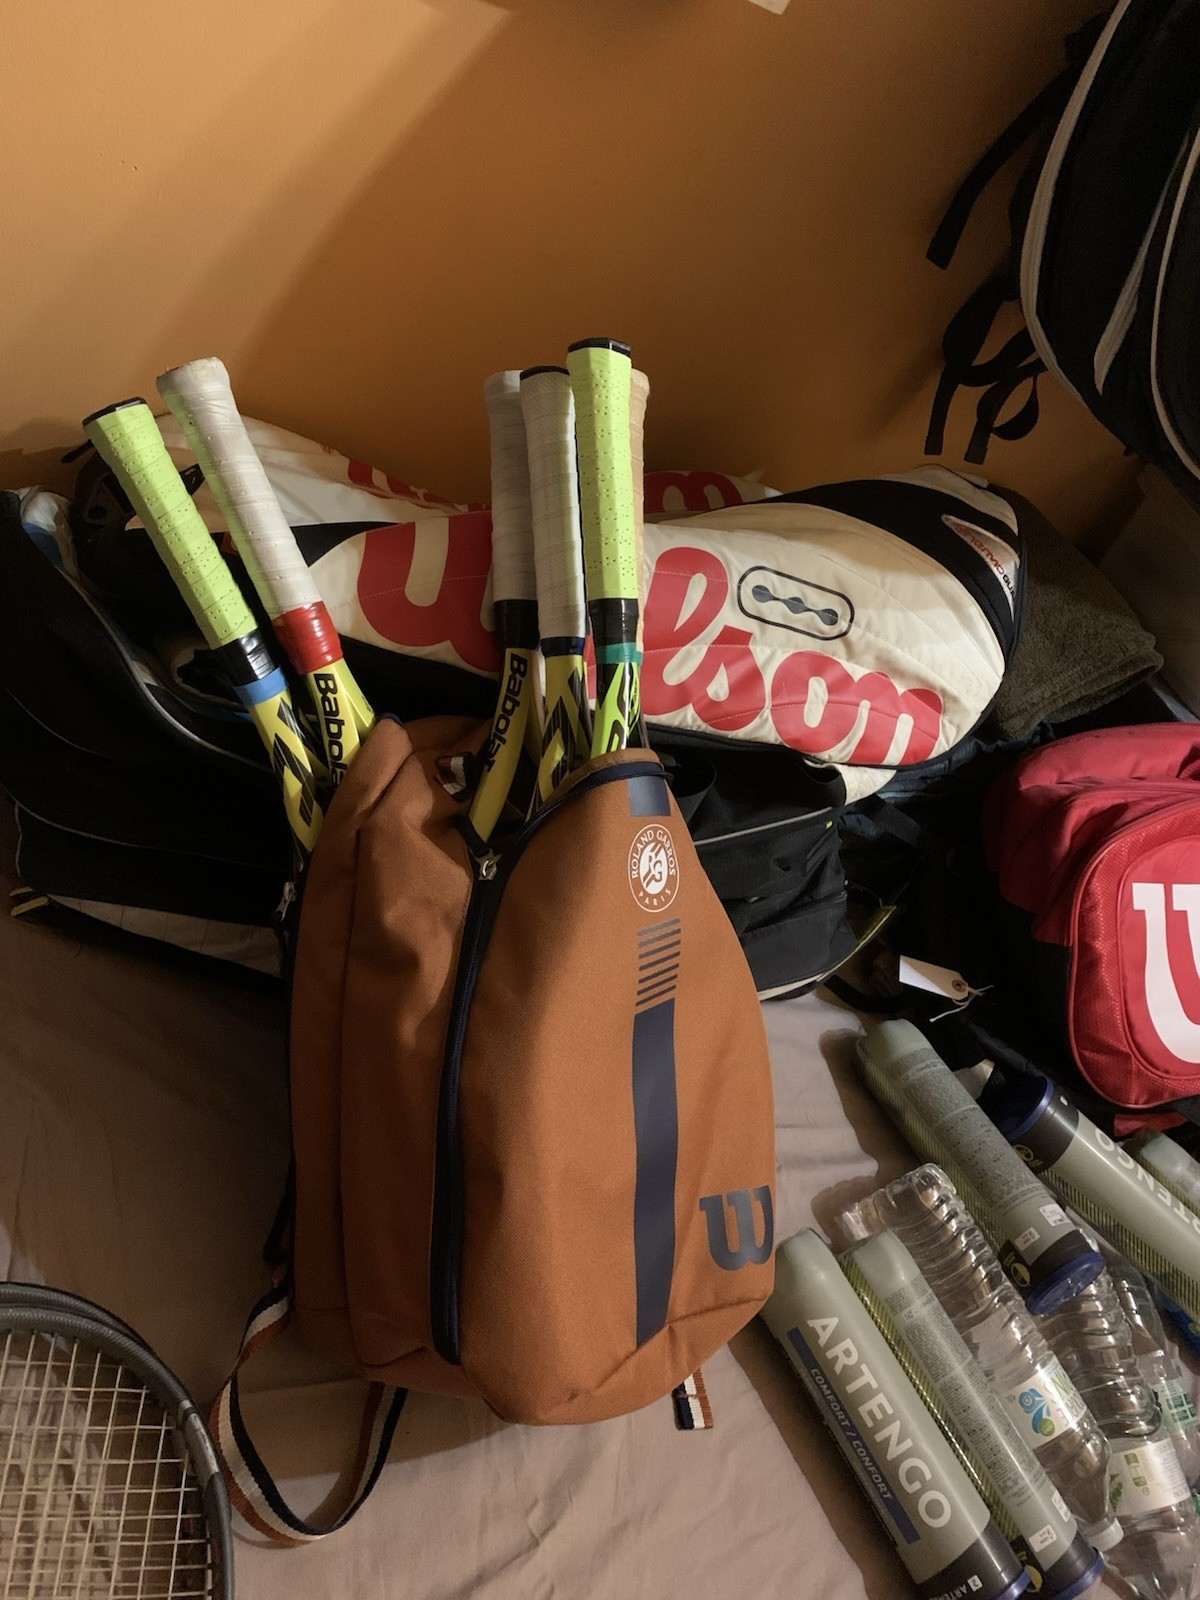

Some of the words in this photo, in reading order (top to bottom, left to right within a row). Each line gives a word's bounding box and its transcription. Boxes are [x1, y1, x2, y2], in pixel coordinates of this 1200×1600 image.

[483, 652, 528, 774] Babolat
[631, 830, 654, 879] ROLAND
[656, 830, 676, 876] GARROS
[639, 888, 671, 906] PARIS
[699, 1185, 774, 1271] W
[807, 1317, 951, 1528] ARTENGO
[811, 1368, 850, 1428] COMFORT
[852, 1440, 893, 1500] CONFORT
